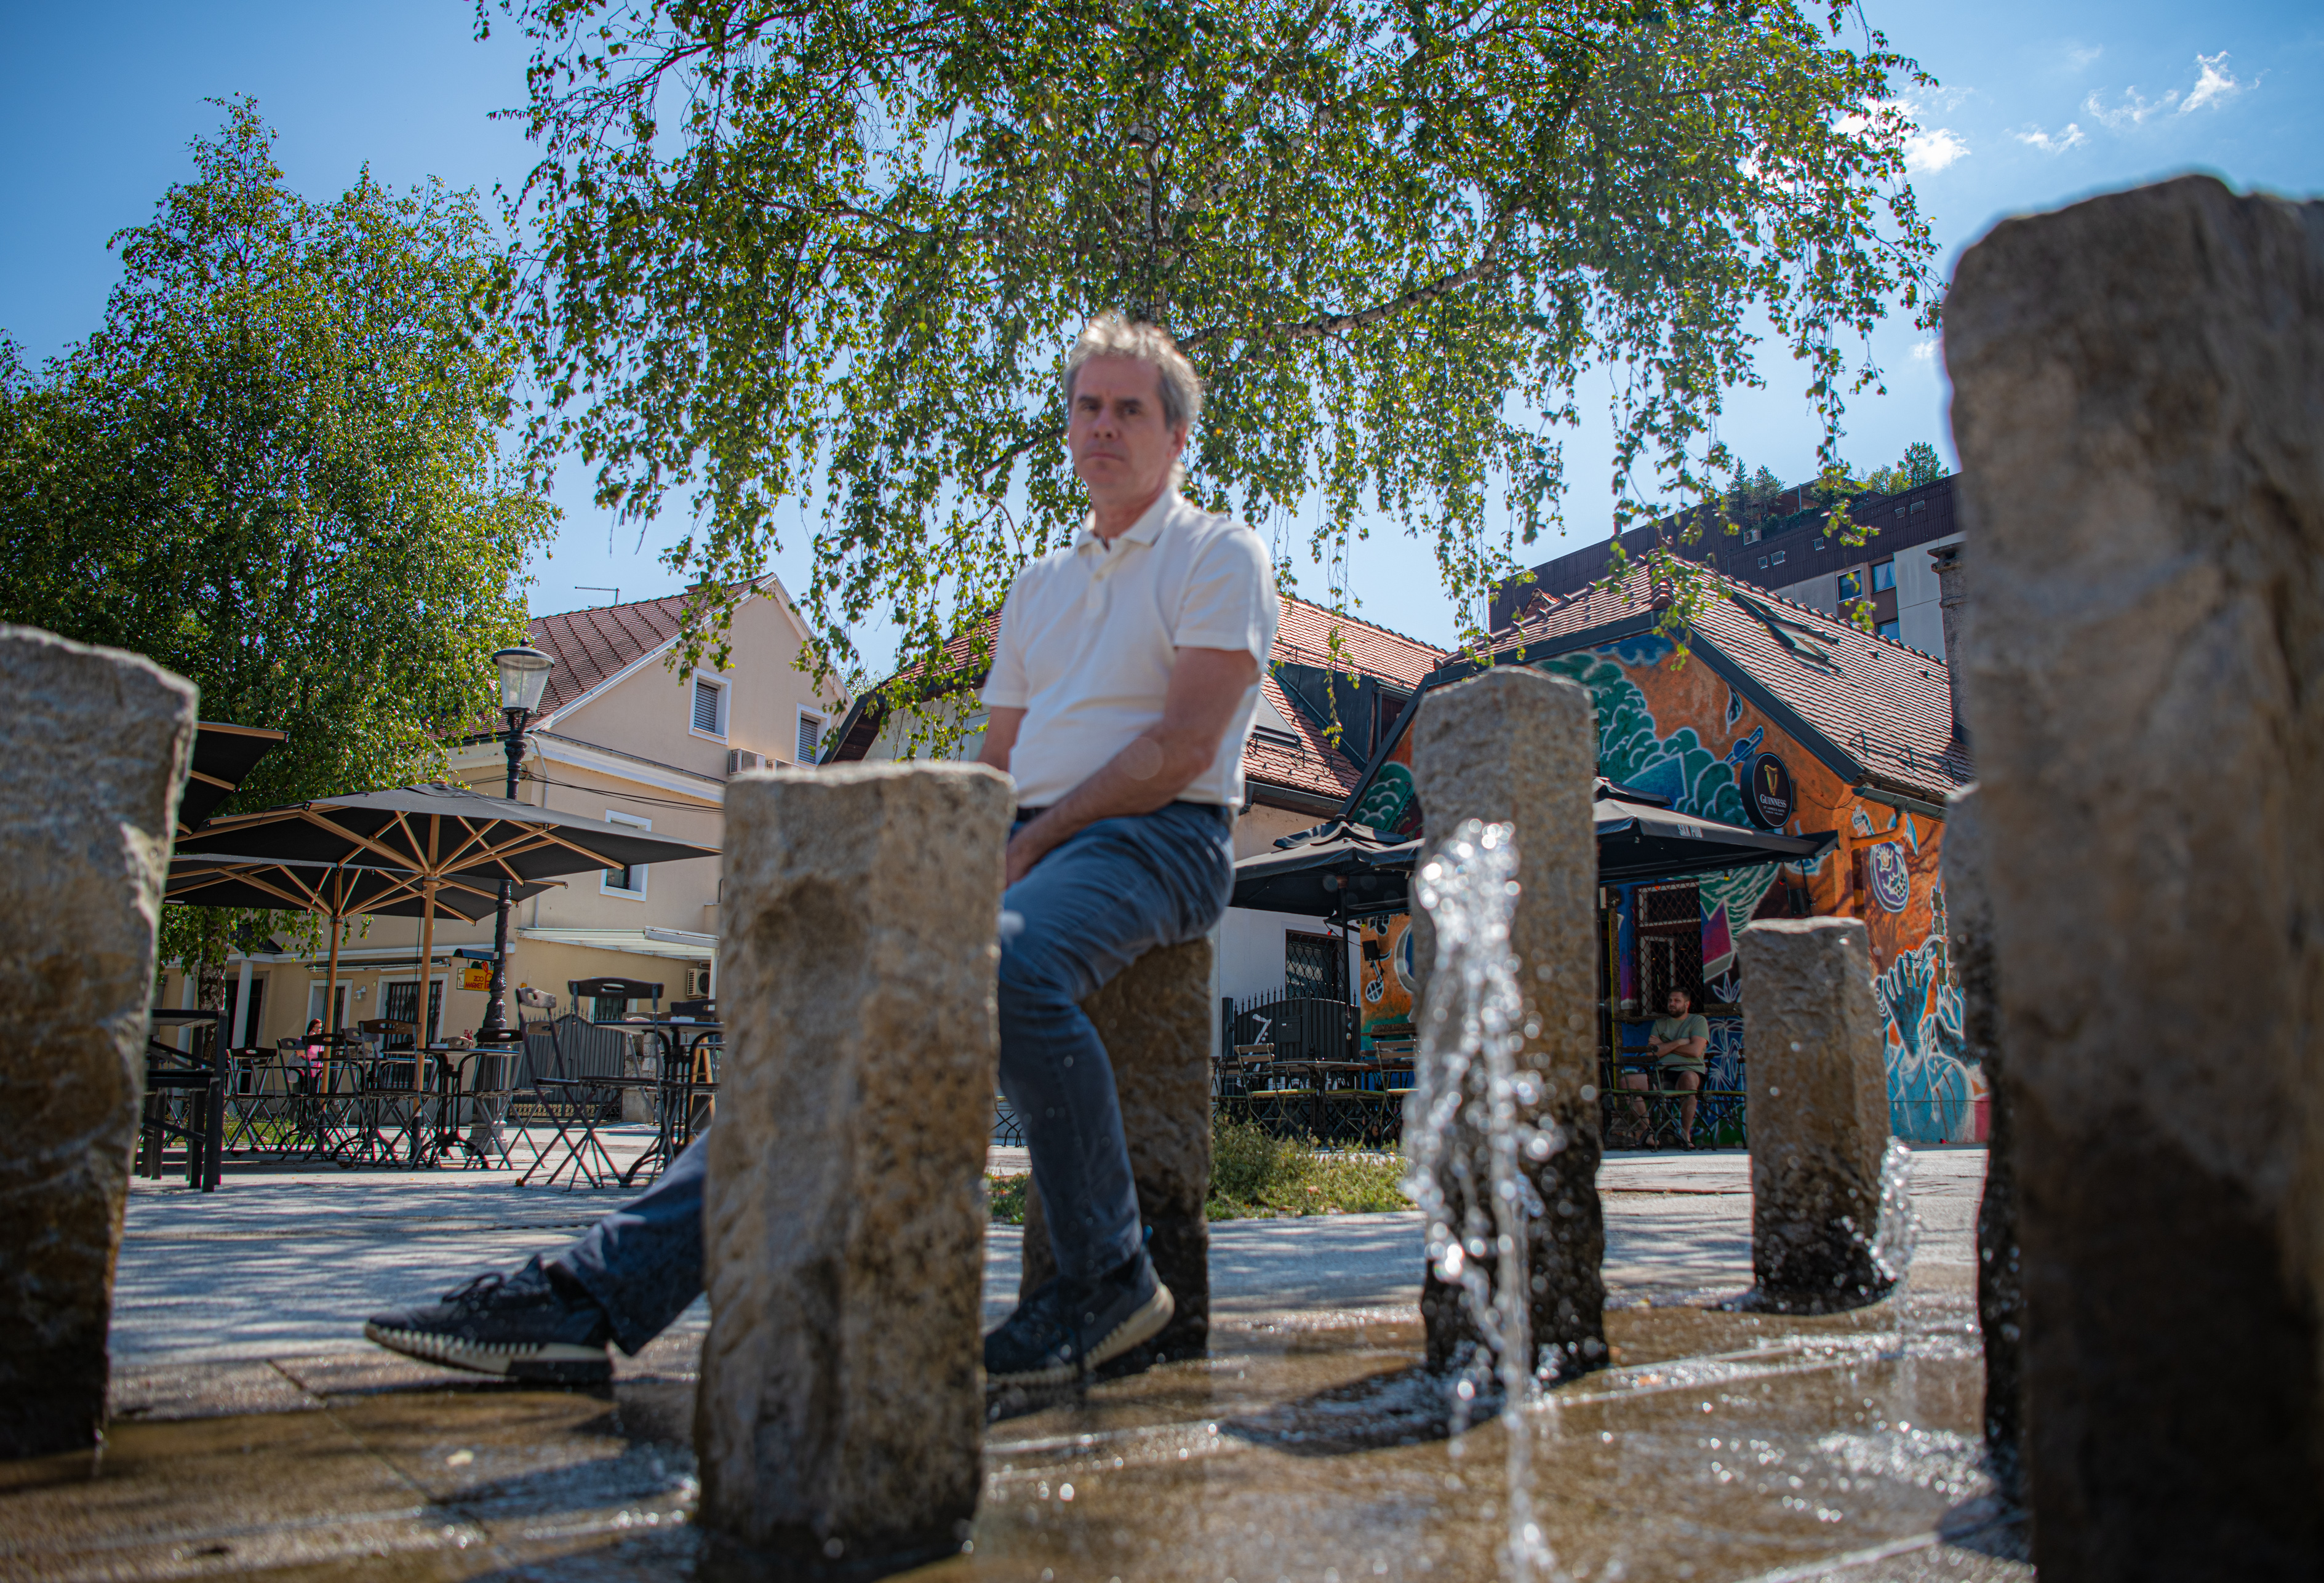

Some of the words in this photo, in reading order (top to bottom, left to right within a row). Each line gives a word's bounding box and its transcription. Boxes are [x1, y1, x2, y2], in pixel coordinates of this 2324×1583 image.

[1760, 794, 1787, 808] GUINNESS
[1677, 824, 1691, 837] SAX
[1690, 825, 1703, 838] PUB
